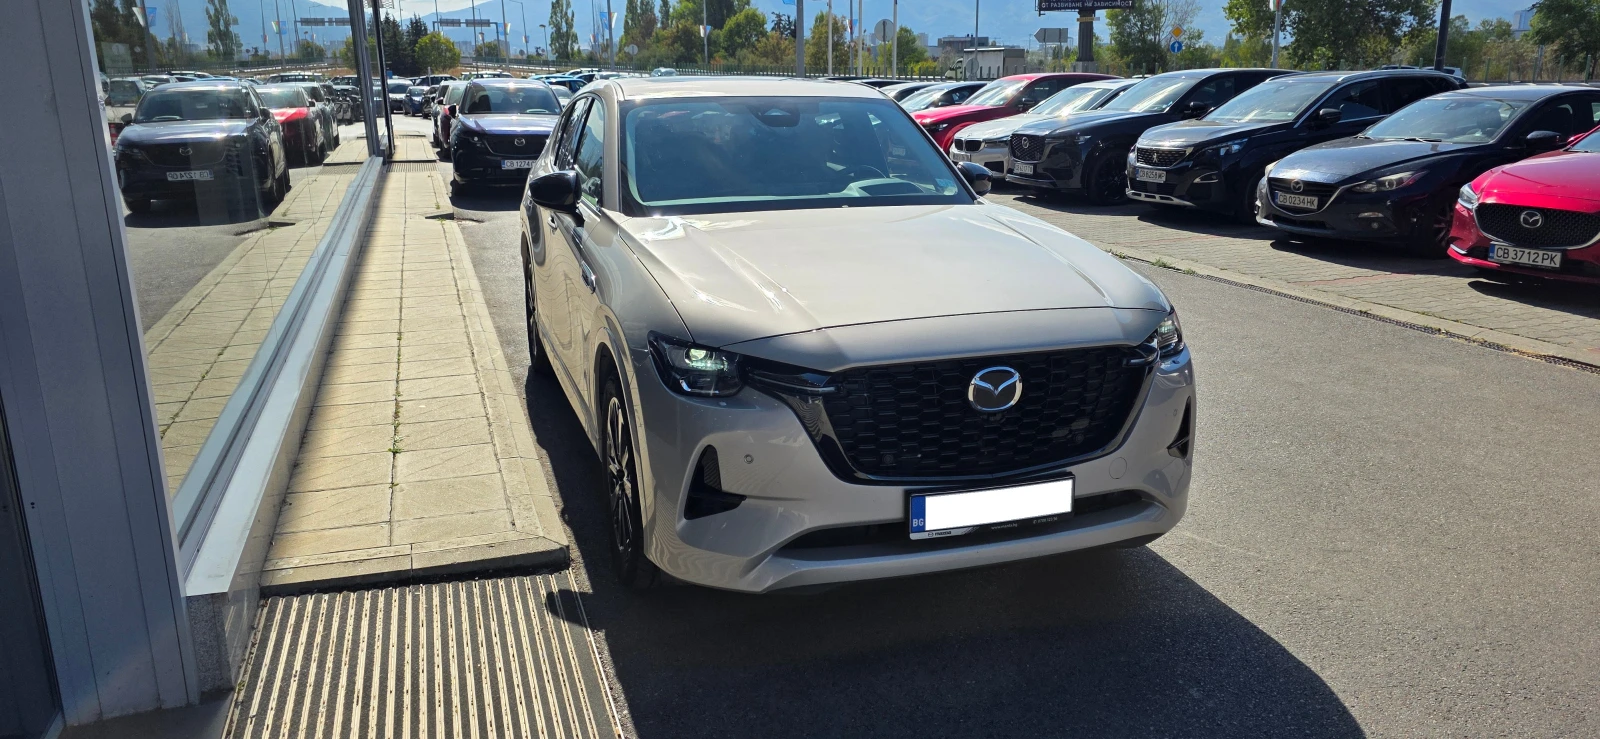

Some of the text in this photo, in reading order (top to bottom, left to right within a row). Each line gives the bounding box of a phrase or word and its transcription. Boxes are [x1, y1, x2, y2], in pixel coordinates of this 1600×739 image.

[506, 160, 515, 168] CB
[516, 160, 530, 168] 1274
[1279, 194, 1316, 207] CB 0234 HK
[1496, 247, 1558, 265] CB 3712 PK
[912, 518, 924, 527] BG
